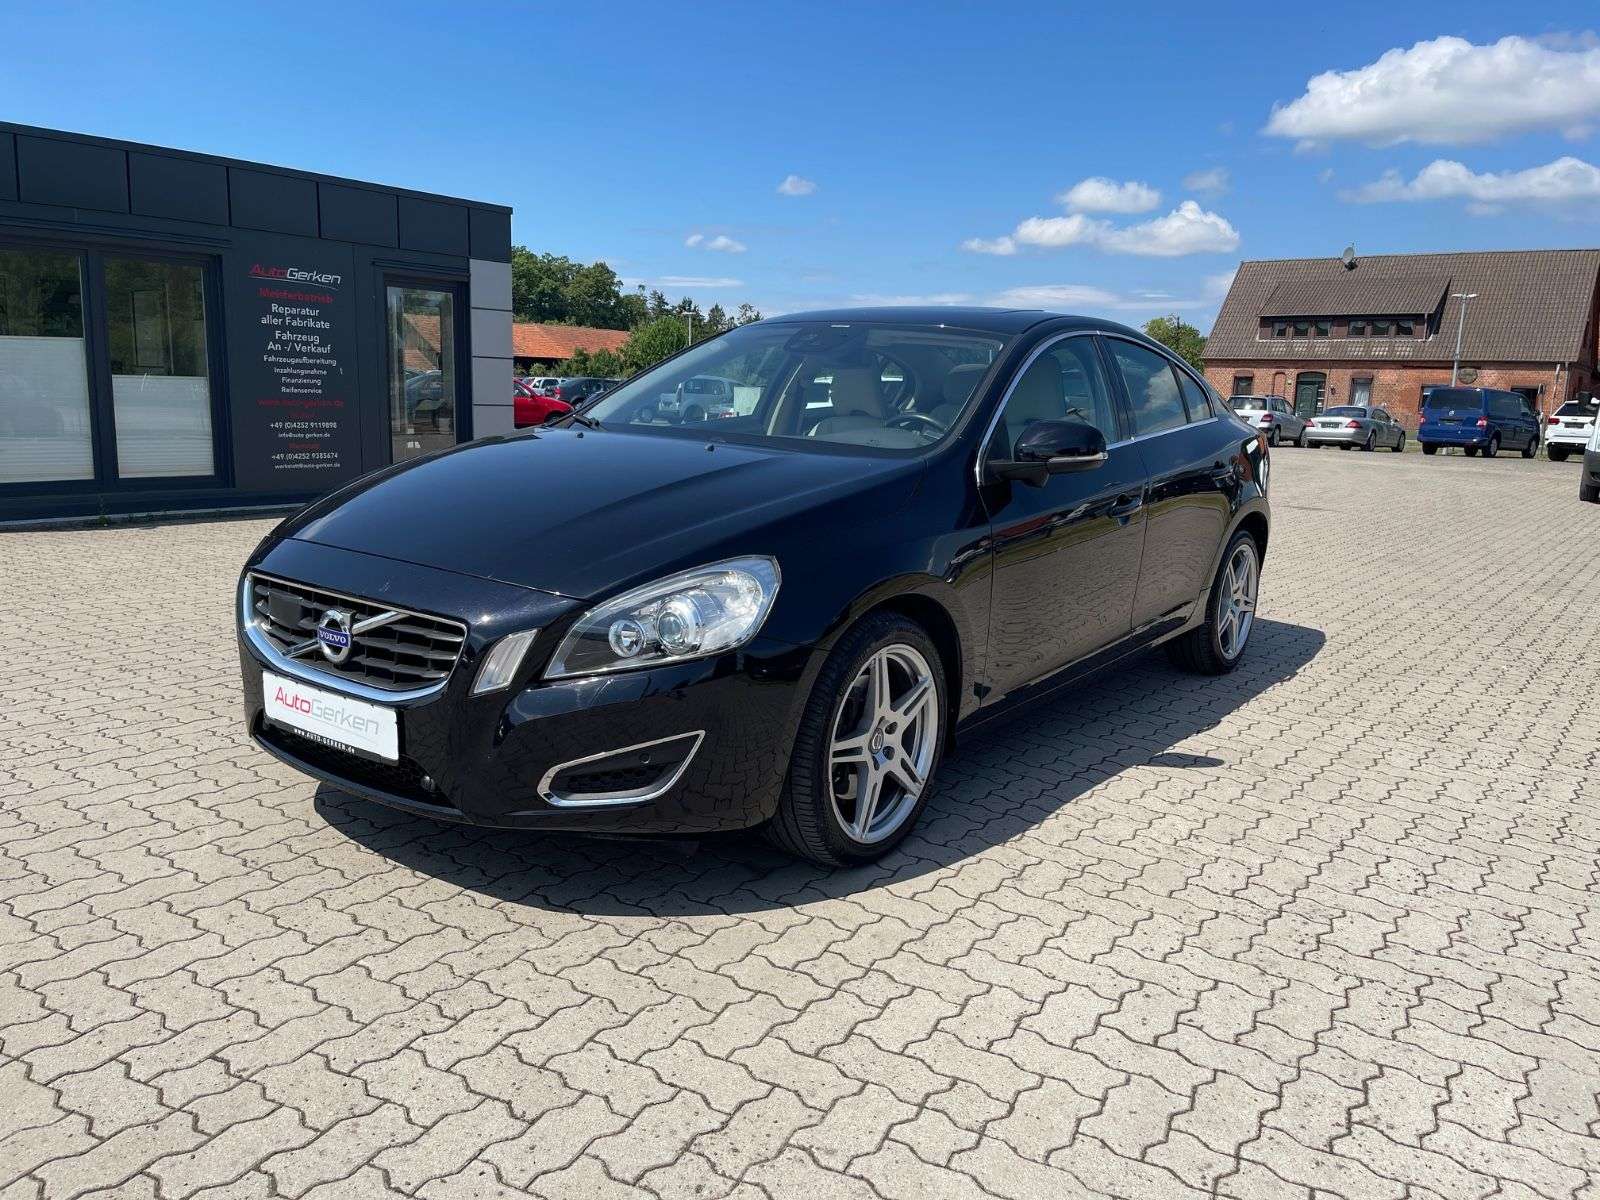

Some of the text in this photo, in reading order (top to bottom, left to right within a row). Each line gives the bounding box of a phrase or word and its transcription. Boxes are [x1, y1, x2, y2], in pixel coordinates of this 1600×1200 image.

[271, 303, 320, 317] Reparatur
[261, 315, 331, 329] aller Fabrikate
[275, 330, 320, 344] Fahrzeug
[267, 341, 282, 351] An
[294, 342, 331, 354] Verkauf
[263, 354, 337, 367] Fahrzeugaufbereitung
[281, 377, 322, 386] Finanzierung
[281, 386, 322, 394] Reifenservice
[284, 421, 309, 430] (0)4252
[286, 452, 310, 460] (0)4252
[318, 629, 348, 645] VOLVO
[274, 685, 380, 736] AutoGerken
